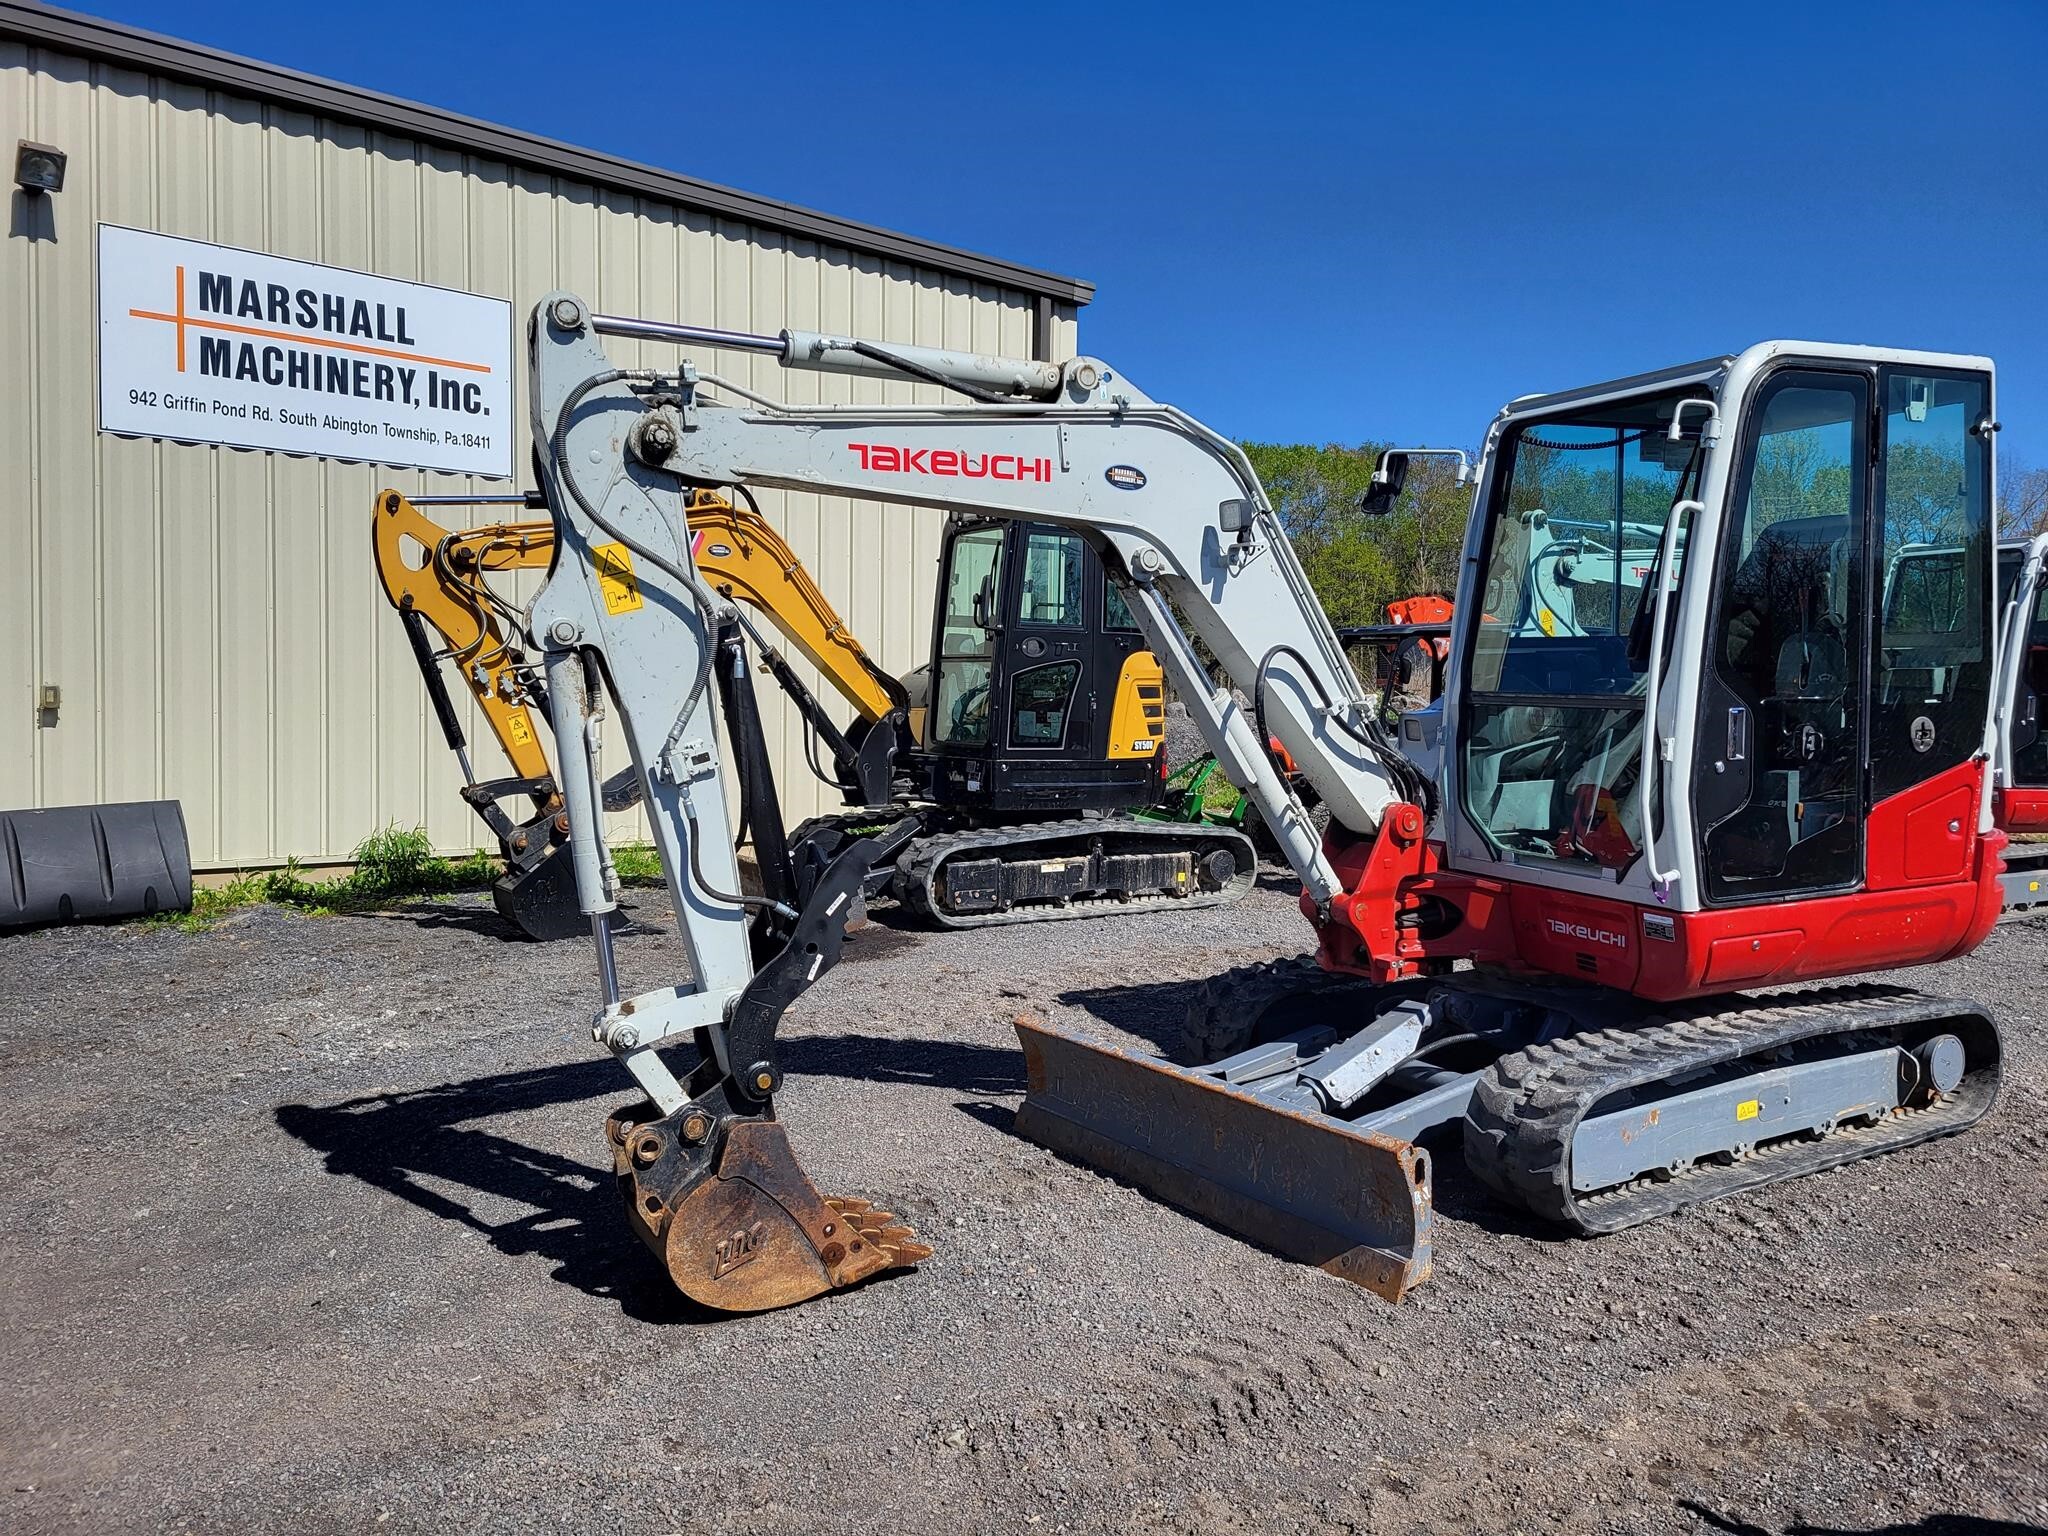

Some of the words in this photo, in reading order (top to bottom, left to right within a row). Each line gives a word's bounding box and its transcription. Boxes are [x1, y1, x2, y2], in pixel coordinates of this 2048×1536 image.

[198, 270, 415, 346] MARSHALL
[199, 335, 421, 410] MACHINERY,
[428, 370, 490, 417] Inc.
[128, 388, 158, 407] 942
[163, 393, 207, 414] Griffin
[212, 400, 247, 419] Pond
[252, 405, 274, 422] Rd.
[279, 408, 317, 427] South
[322, 414, 378, 435] Abington
[382, 422, 440, 446] Township,
